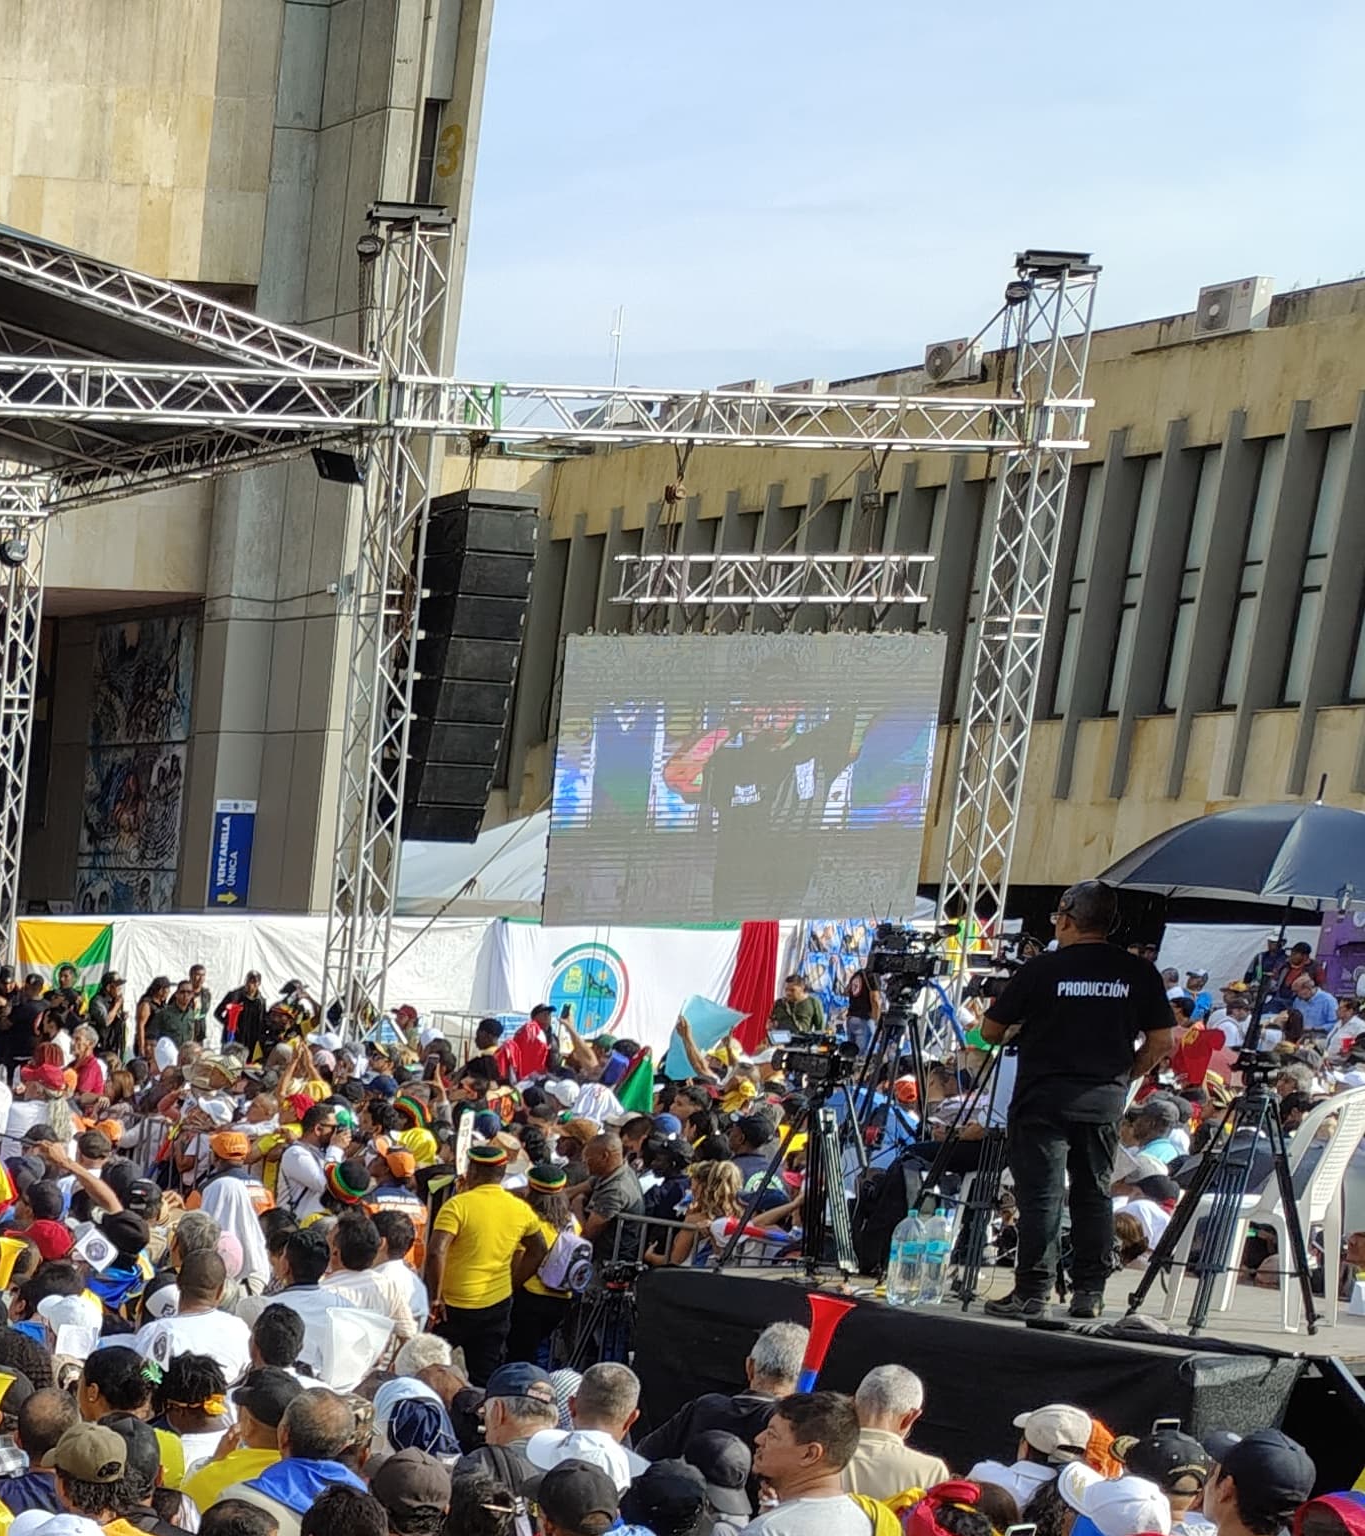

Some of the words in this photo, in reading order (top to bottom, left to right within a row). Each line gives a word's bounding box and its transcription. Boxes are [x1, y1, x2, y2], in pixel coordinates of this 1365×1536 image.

[216, 815, 231, 887] VENTANILLA
[224, 850, 239, 887] ÚNICA
[1057, 978, 1130, 998] PRODUCCIÓN
